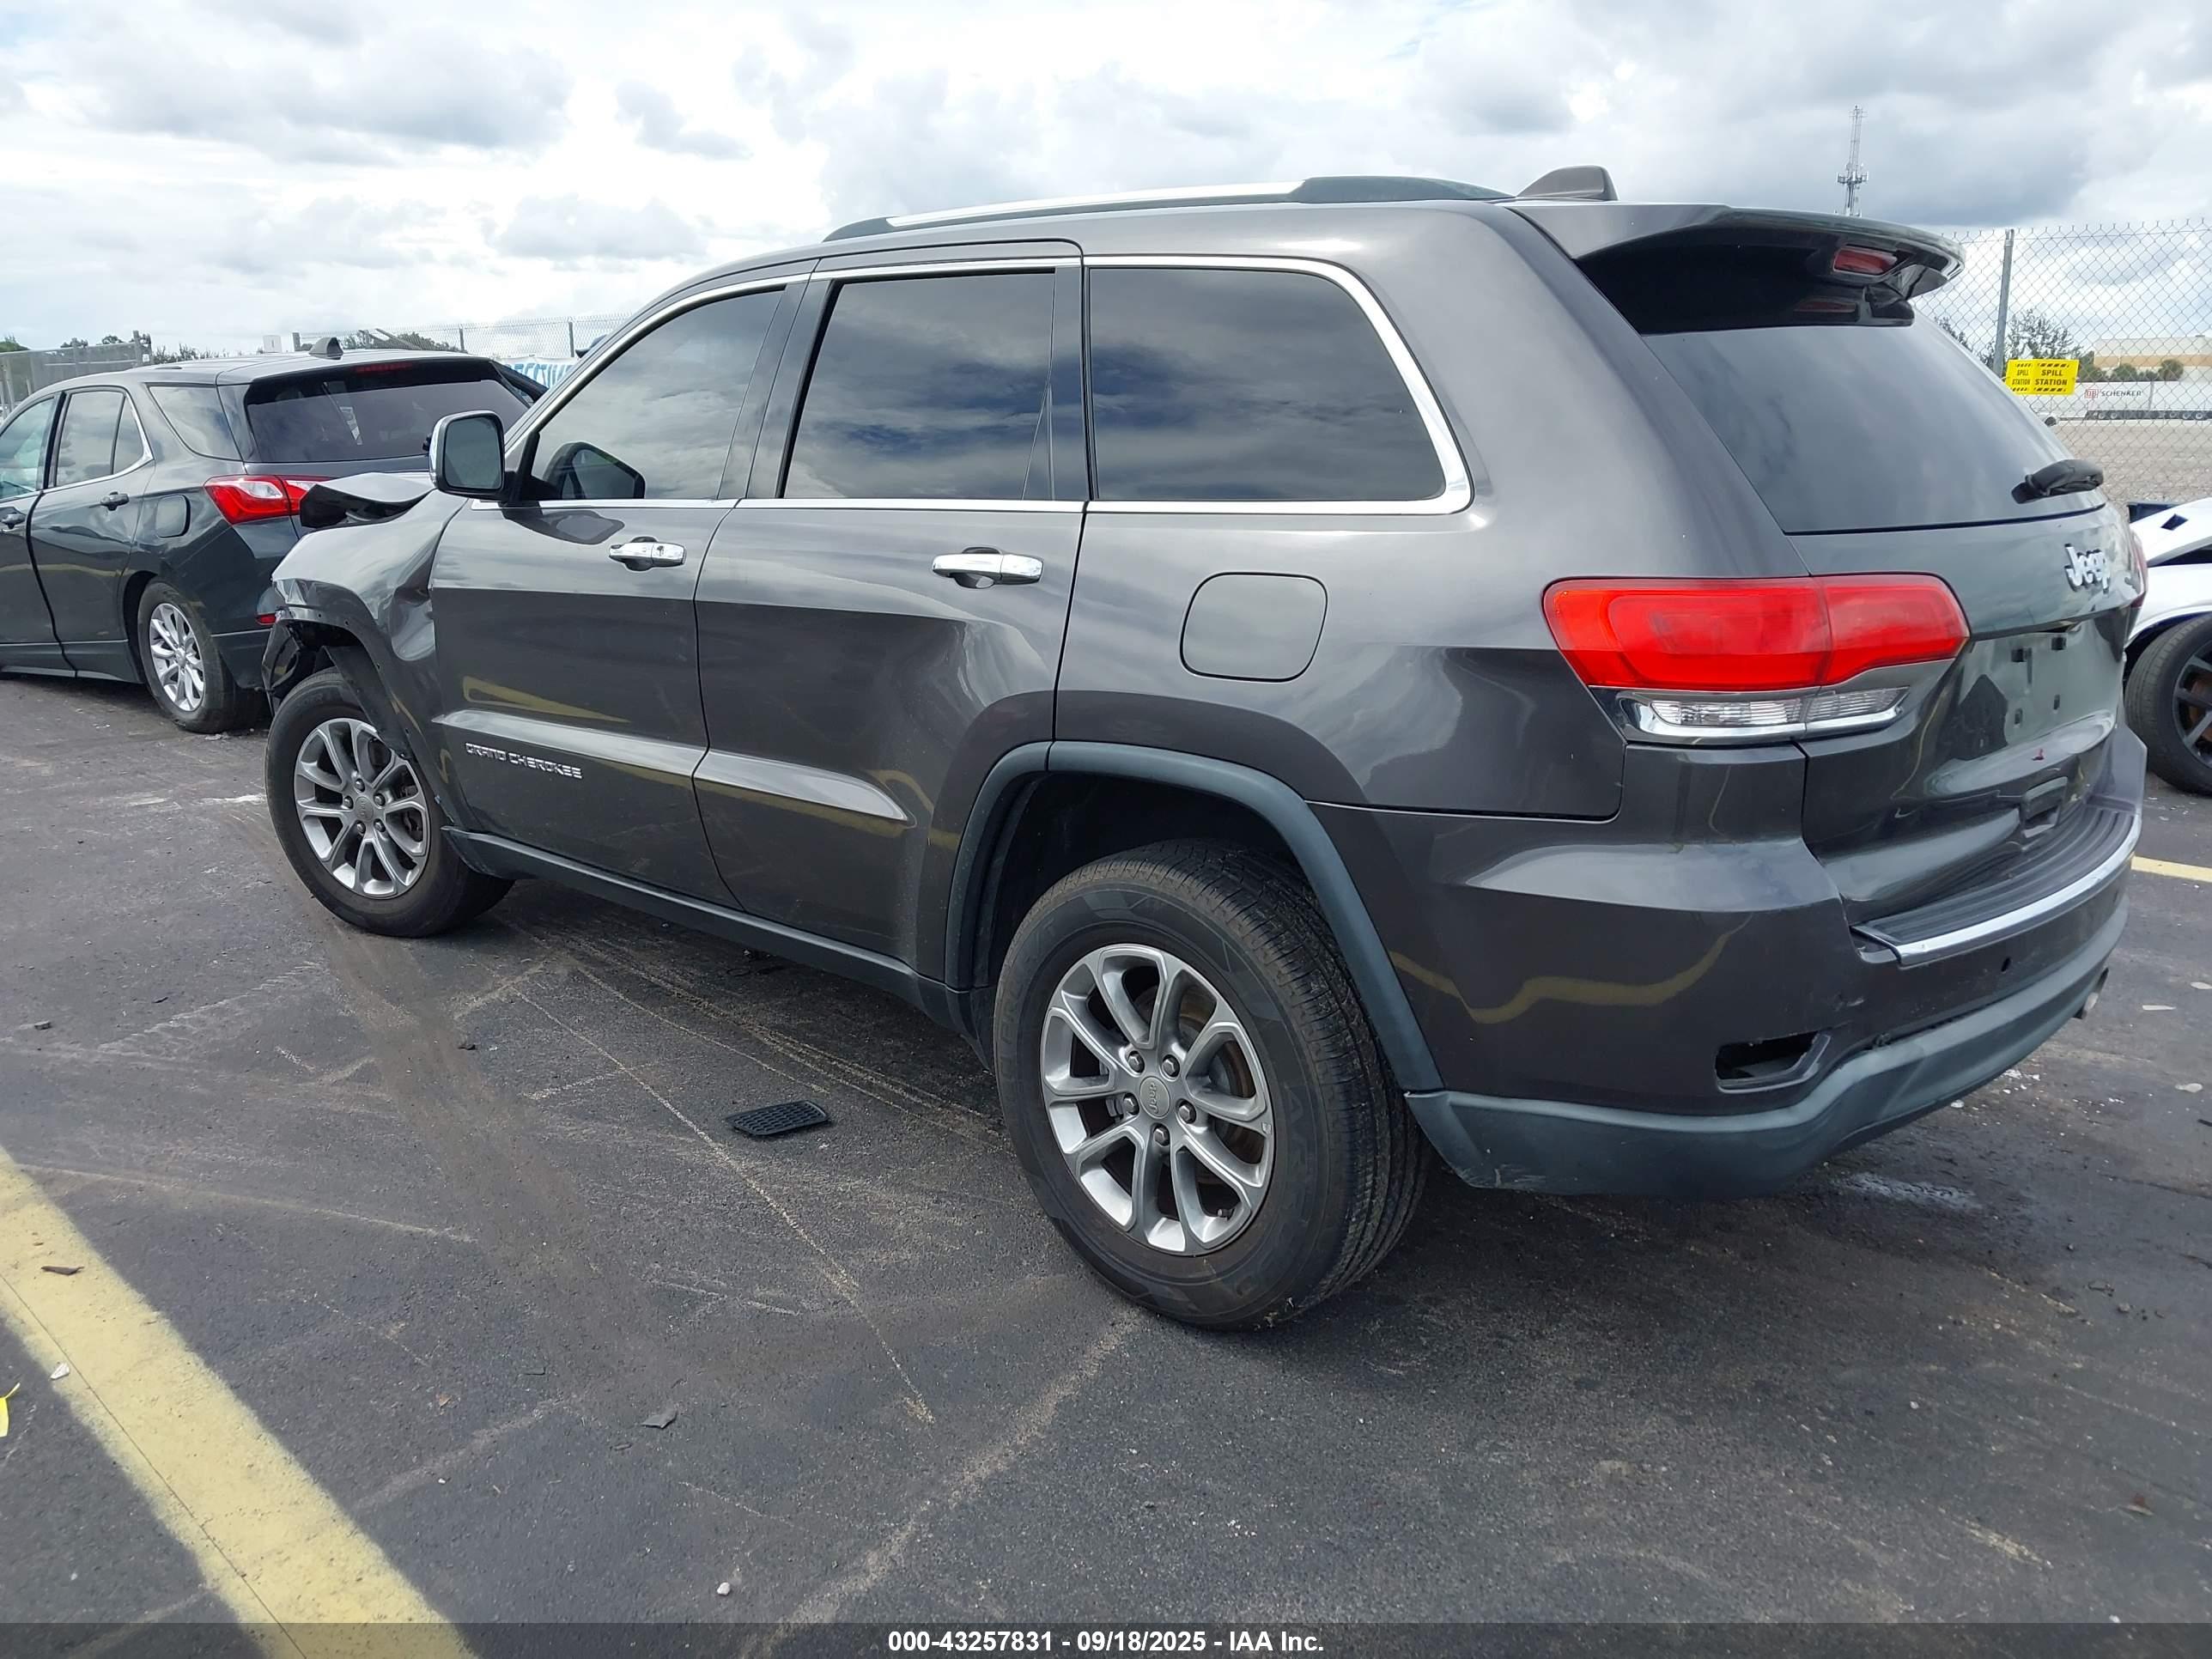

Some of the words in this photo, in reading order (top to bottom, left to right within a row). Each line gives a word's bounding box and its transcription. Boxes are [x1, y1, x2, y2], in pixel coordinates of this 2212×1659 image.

[2064, 544, 2111, 593] Jeep
[465, 742, 507, 762] GRAND
[508, 752, 583, 780] CHEROKEE
